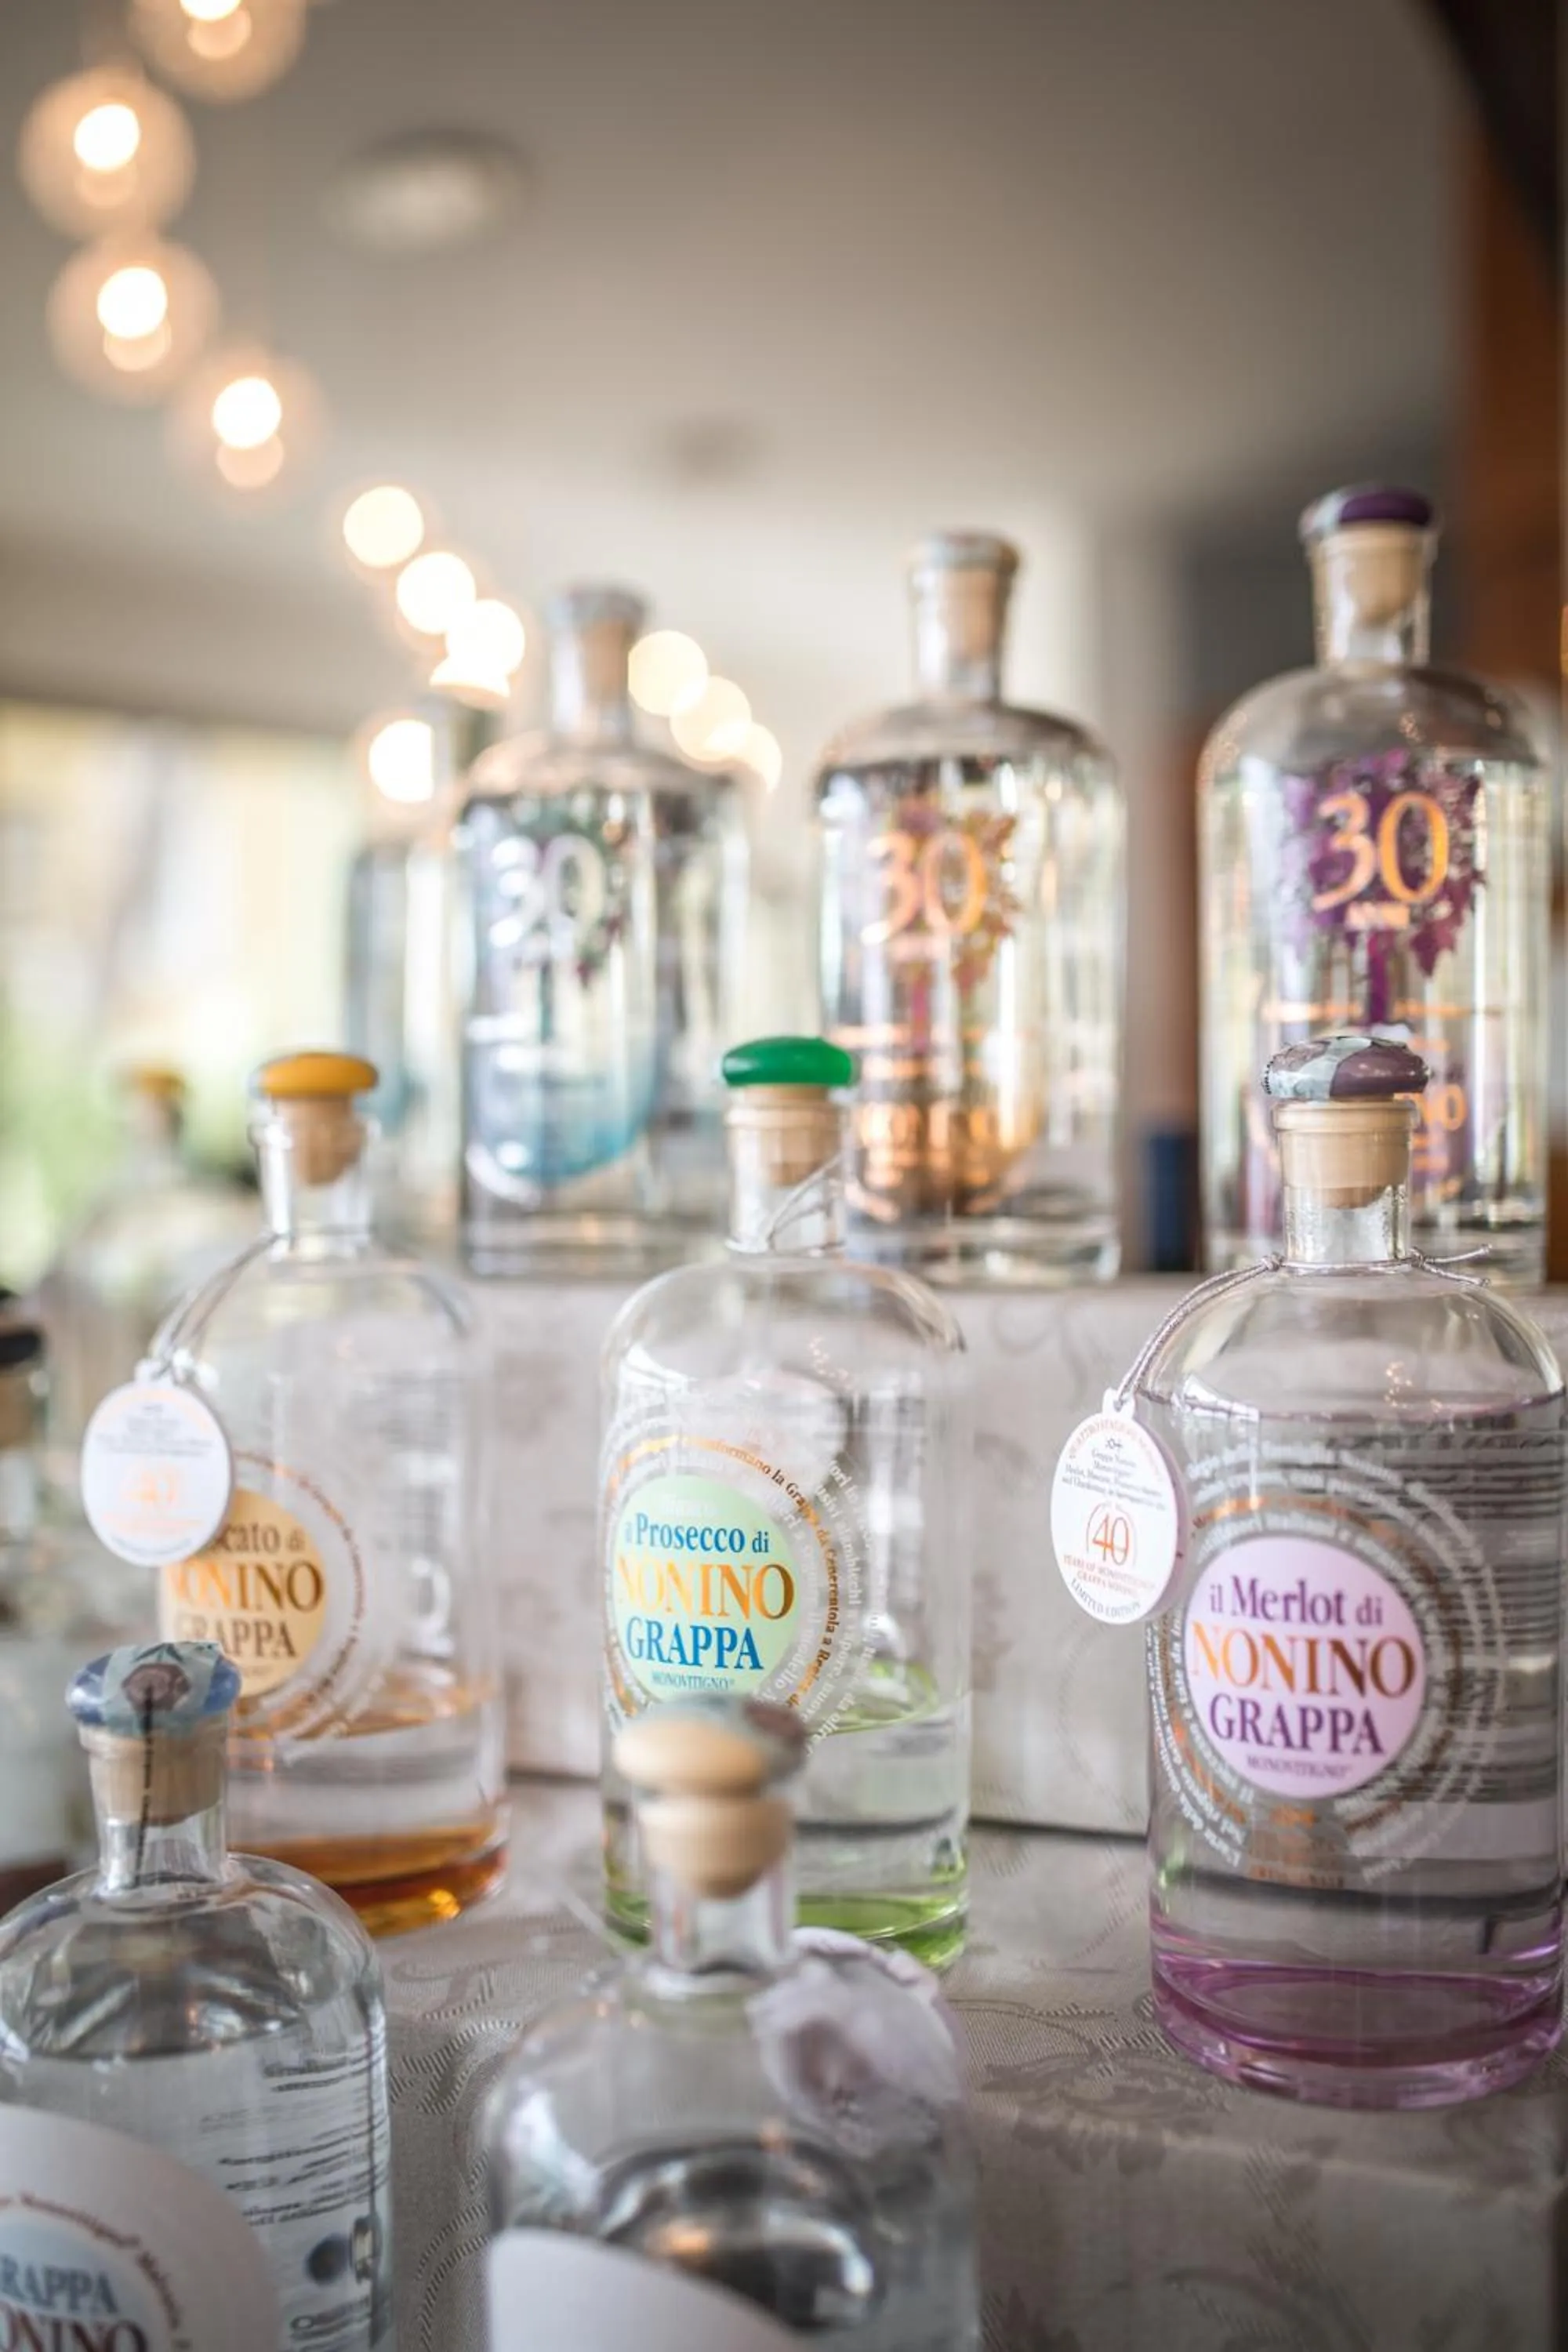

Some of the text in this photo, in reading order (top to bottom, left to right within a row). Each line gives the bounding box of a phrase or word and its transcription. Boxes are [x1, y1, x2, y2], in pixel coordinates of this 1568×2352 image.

[1313, 791, 1450, 912] 30
[862, 829, 987, 946] 30
[771, 1468, 785, 1486] la
[636, 1512, 746, 1553] Prosecco
[752, 1530, 769, 1553] di
[1092, 1513, 1130, 1566] 40
[619, 1552, 795, 1620] NONINO
[1210, 1575, 1383, 1626] il Merlot di
[626, 1617, 764, 1671] GRAPPA
[1192, 1620, 1417, 1699] NONINO
[1210, 1693, 1385, 1755] GRAPPA
